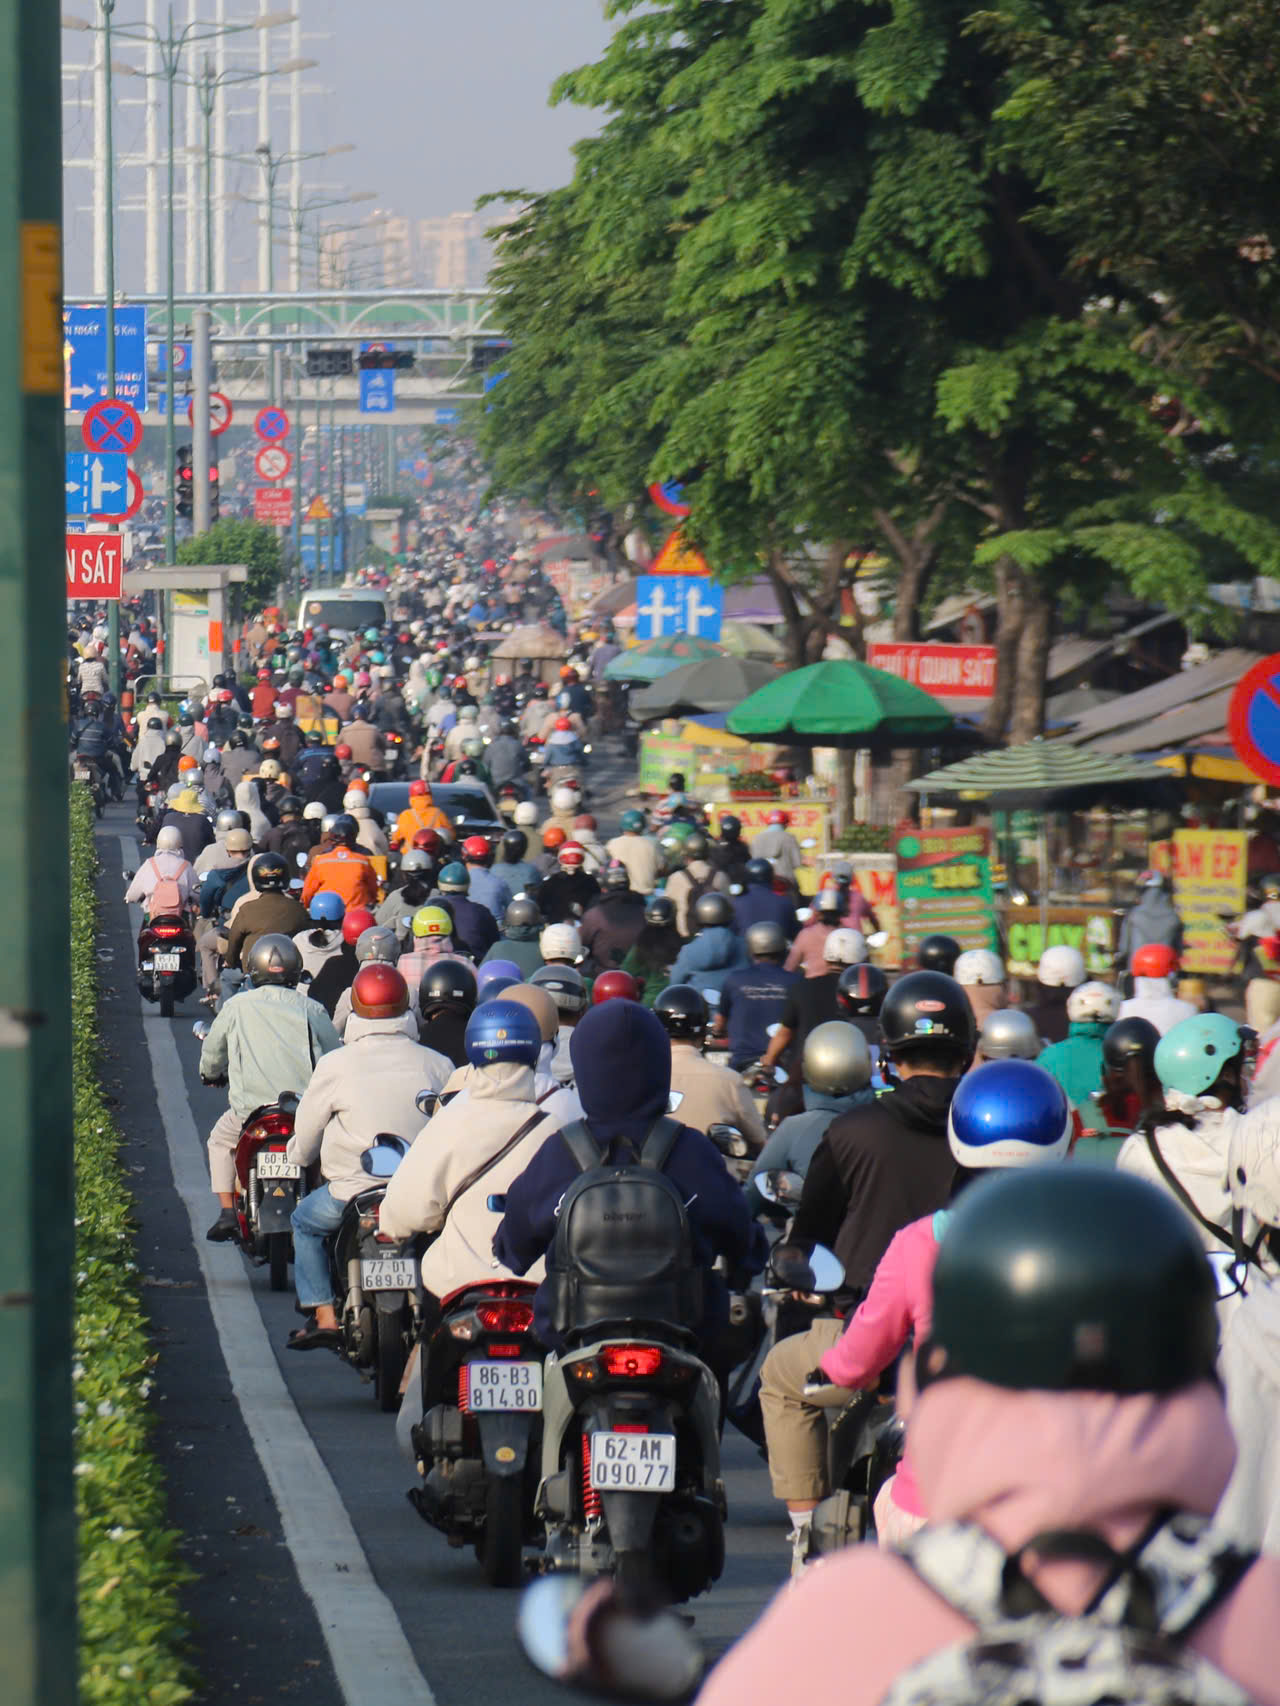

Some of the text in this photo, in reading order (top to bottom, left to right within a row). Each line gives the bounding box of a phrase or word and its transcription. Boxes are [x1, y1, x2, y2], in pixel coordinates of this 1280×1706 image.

[81, 542, 117, 584] SÁT
[963, 651, 997, 687] SÁT
[260, 1165, 298, 1177] 617.21
[366, 1274, 413, 1288] 689.67
[479, 1366, 530, 1386] 86-B3
[473, 1388, 537, 1408] 814.80
[605, 1438, 662, 1461] 62-AM
[596, 1462, 669, 1487] 090.77
